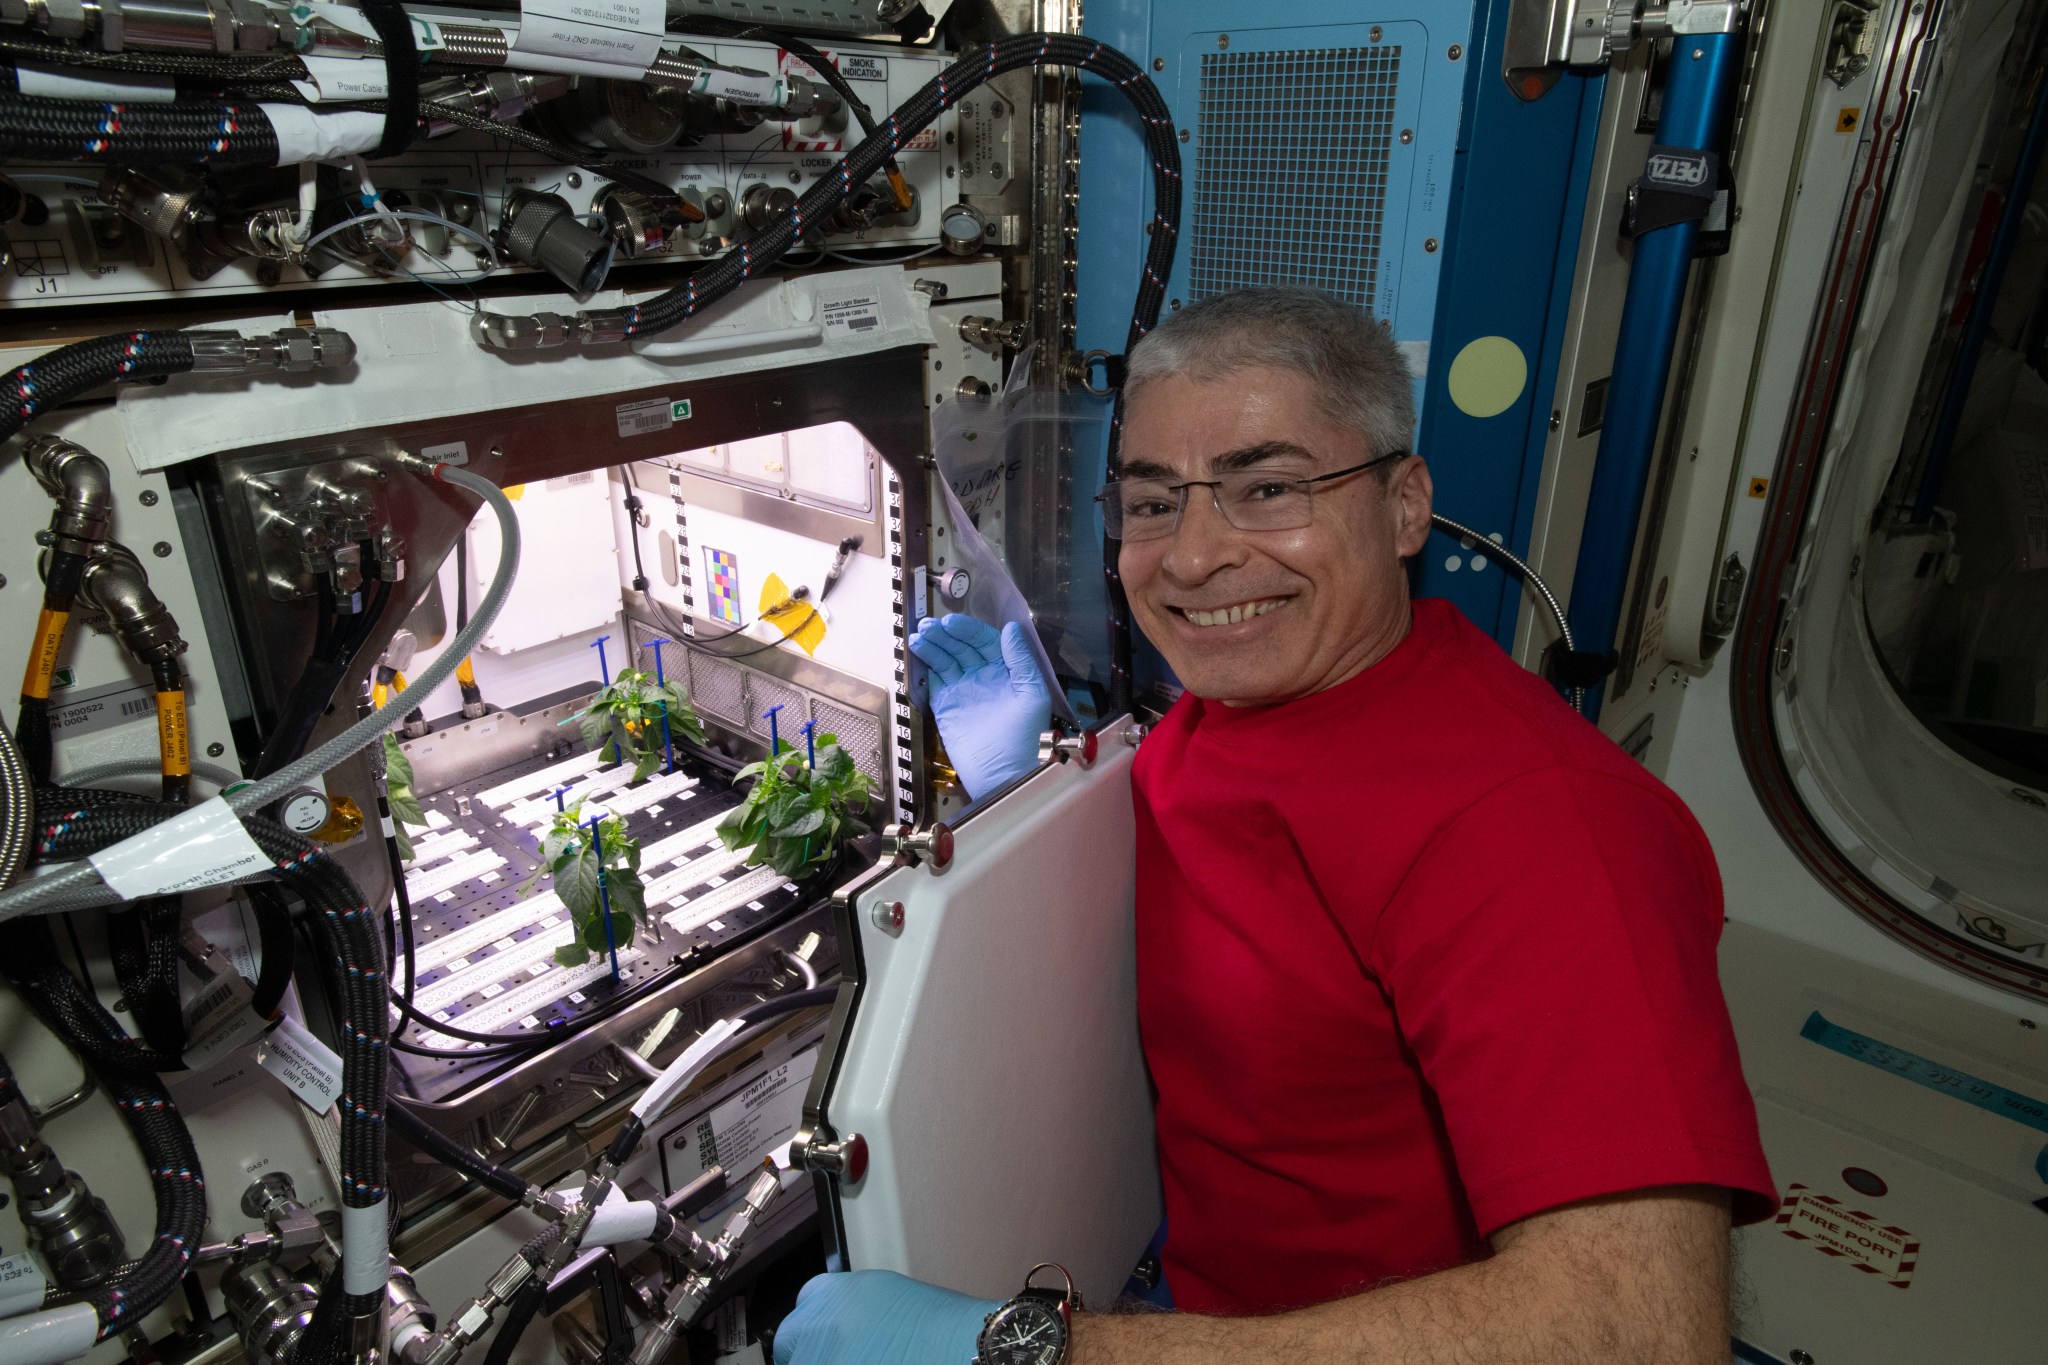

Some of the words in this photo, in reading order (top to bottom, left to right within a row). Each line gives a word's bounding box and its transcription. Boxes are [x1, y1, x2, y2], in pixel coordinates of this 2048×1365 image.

[612, 3, 627, 12] 1001
[627, 6, 641, 15] S/N
[628, 17, 640, 25] P/N
[552, 32, 570, 42] Filter
[571, 35, 589, 44] GN2
[589, 38, 617, 48] Habitat
[618, 43, 635, 51] Plant
[849, 58, 875, 69] SMOKE
[842, 67, 882, 78] INDICATION
[337, 81, 361, 93] Power
[362, 83, 383, 93] Cable
[724, 86, 761, 99] NITROGEN
[653, 160, 660, 169] 7
[801, 157, 832, 168] LOCKER
[1649, 156, 1706, 184] PETZL
[421, 178, 449, 186] POWER
[81, 195, 98, 204] ON
[99, 266, 119, 274] OFF
[36, 277, 58, 294] J1
[823, 302, 841, 310] Growth
[841, 299, 853, 308] Light
[853, 297, 870, 305] Blanket
[617, 403, 636, 412] Growth
[432, 452, 444, 461] Air
[445, 450, 460, 460] Inlet
[671, 484, 680, 496] 32
[676, 504, 685, 516] 30
[678, 524, 687, 536] 28
[682, 566, 690, 576] 24
[684, 585, 692, 596] 22
[45, 633, 56, 663] DATA
[40, 662, 50, 676] J401
[62, 702, 105, 719] 1900522
[176, 700, 184, 712] To
[898, 704, 909, 718] 18
[64, 715, 89, 727] 0004
[165, 709, 173, 739] POWER
[176, 712, 185, 729] ECS
[899, 726, 910, 739] 16
[166, 740, 175, 759] J402
[177, 730, 186, 757] (Panel
[899, 747, 911, 761] 14
[900, 768, 911, 782] 12
[901, 789, 912, 802] 10
[903, 810, 910, 821] 8
[157, 872, 201, 894] Growth
[203, 853, 257, 878] Chamber
[452, 959, 465, 968] 18
[533, 964, 545, 972] 11
[619, 970, 627, 978] 4
[485, 985, 499, 995] 10
[572, 993, 582, 1002] 3
[230, 1018, 247, 1032] Data
[524, 1018, 533, 1026] 2
[209, 1031, 230, 1047] Cable
[270, 1042, 303, 1070] HUMIDITY
[301, 1068, 331, 1097] CONTROL
[212, 1073, 238, 1089] PANEL
[283, 1067, 300, 1084] UNIT
[298, 1080, 306, 1089] B
[326, 1074, 334, 1085] B)
[740, 1065, 789, 1103] JPM1F1_L2
[1928, 1069, 1963, 1089] the
[1969, 1082, 1994, 1101] in
[697, 1120, 711, 1134] RE
[773, 1124, 792, 1138] Material
[698, 1130, 712, 1143] TR
[246, 1161, 263, 1173] GAS
[1802, 1195, 1876, 1233] EMERGENCY
[1877, 1226, 1904, 1246] USE
[1797, 1209, 1841, 1235] FIRE
[1844, 1229, 1899, 1260] PORT
[1814, 1232, 1871, 1263] JPM1D0-1
[2, 1269, 22, 1282] ECS
[23, 1265, 34, 1275] To
